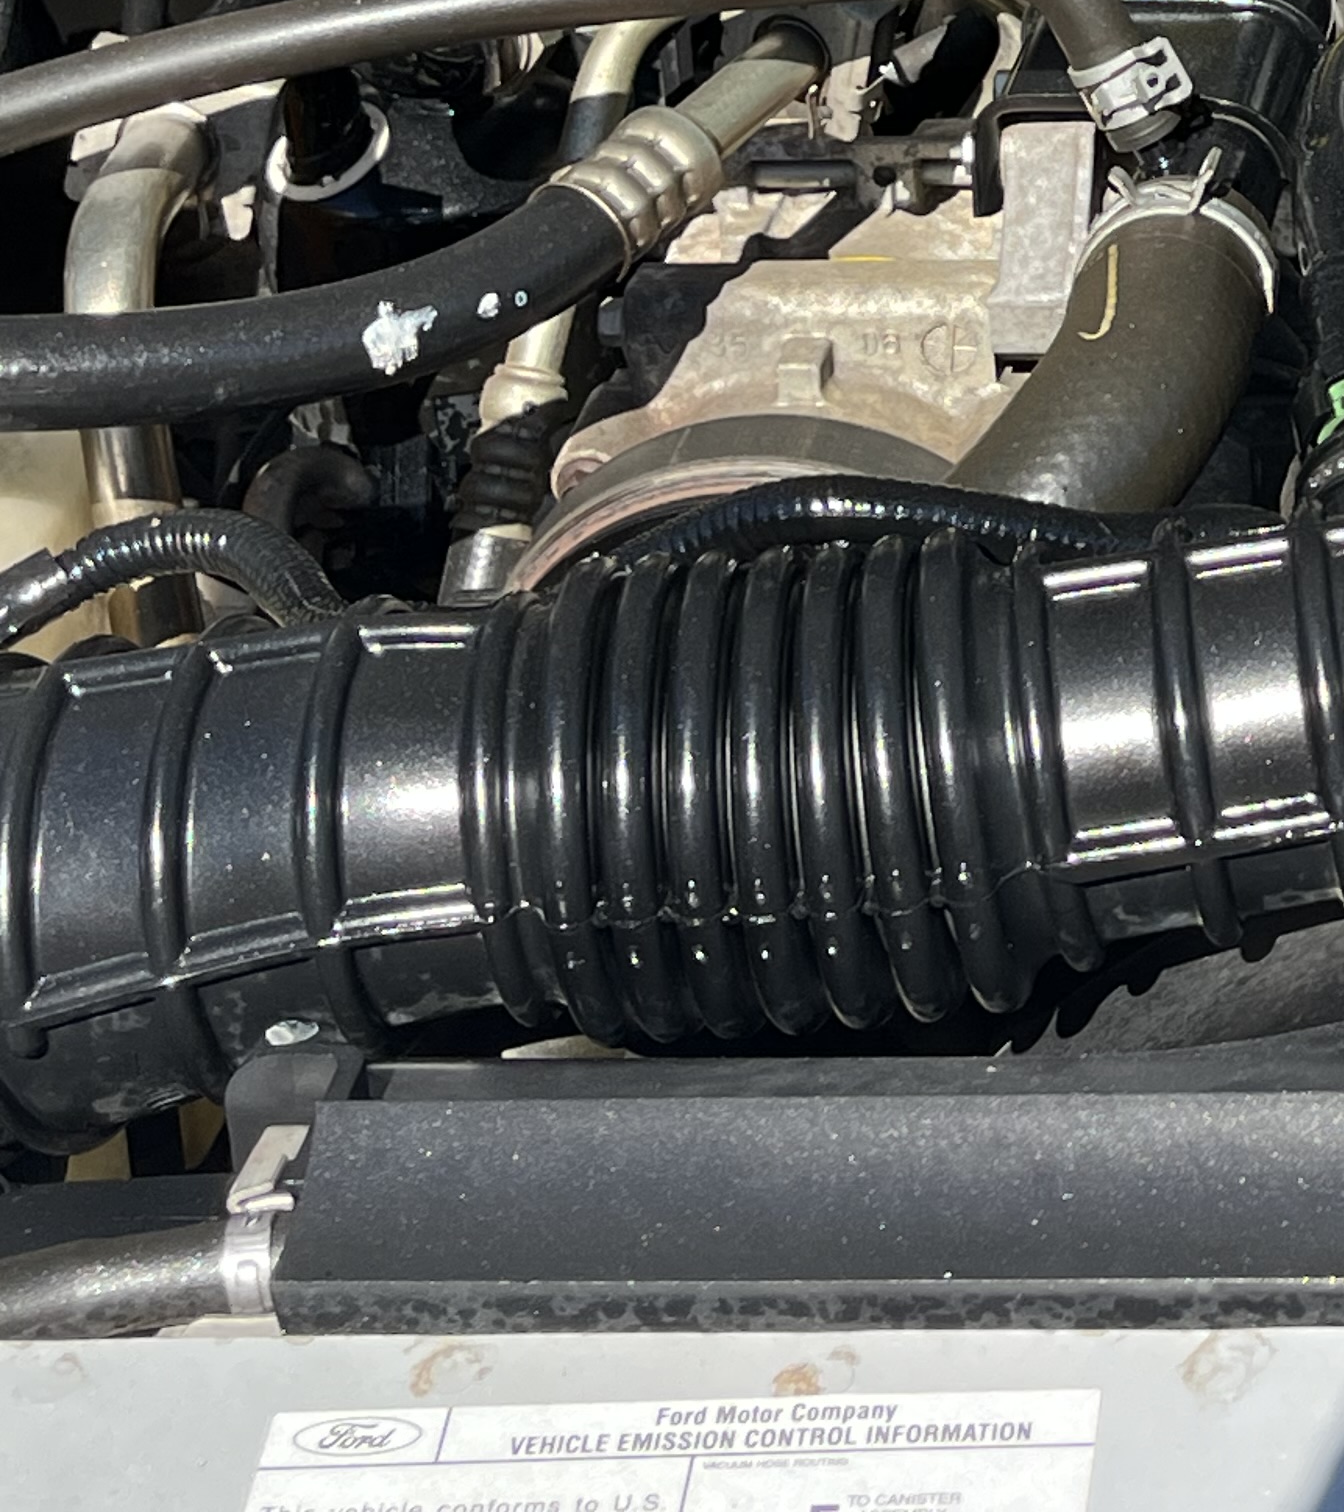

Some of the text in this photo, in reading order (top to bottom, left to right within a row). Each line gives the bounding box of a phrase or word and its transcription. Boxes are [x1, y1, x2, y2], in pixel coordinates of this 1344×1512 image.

[656, 1402, 898, 1426] Ford Motor Company
[317, 1422, 398, 1451] Ford
[511, 1421, 1034, 1456] VEHICLE EMISSION CONTROL INFORMATION
[576, 1496, 600, 1512] to
[614, 1492, 669, 1511] U.S.
[847, 1491, 962, 1507] TO CANISTER
